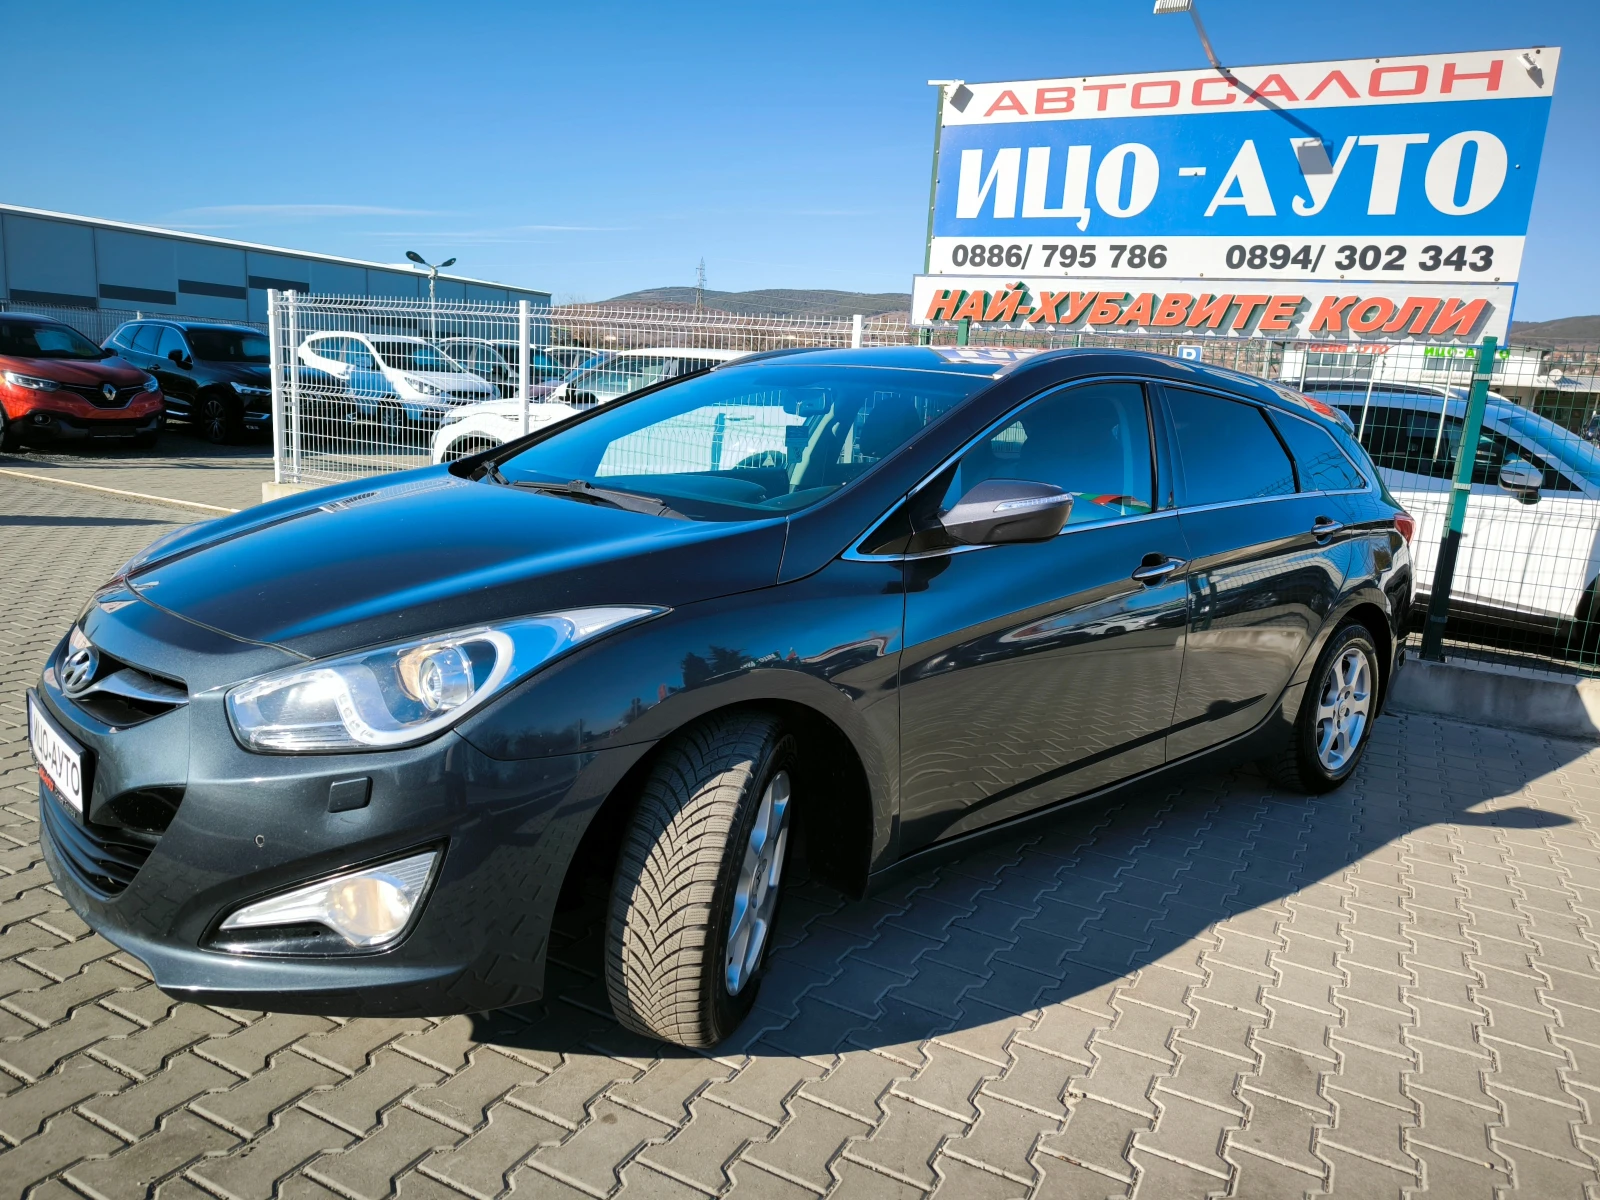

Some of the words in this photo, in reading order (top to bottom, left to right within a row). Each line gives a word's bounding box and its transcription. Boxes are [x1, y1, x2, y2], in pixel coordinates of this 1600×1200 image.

[983, 60, 1504, 117] АВТОСАЛОН
[951, 244, 1033, 270] 0886/
[1041, 244, 1097, 269] 795
[1108, 244, 1168, 269] 786
[1225, 244, 1326, 273] 0894/
[1334, 245, 1407, 271] 302
[1418, 245, 1494, 272] 343
[925, 281, 1302, 330] НАЙ-ХУБАВИТЕ
[1308, 295, 1488, 335] КОЛИ
